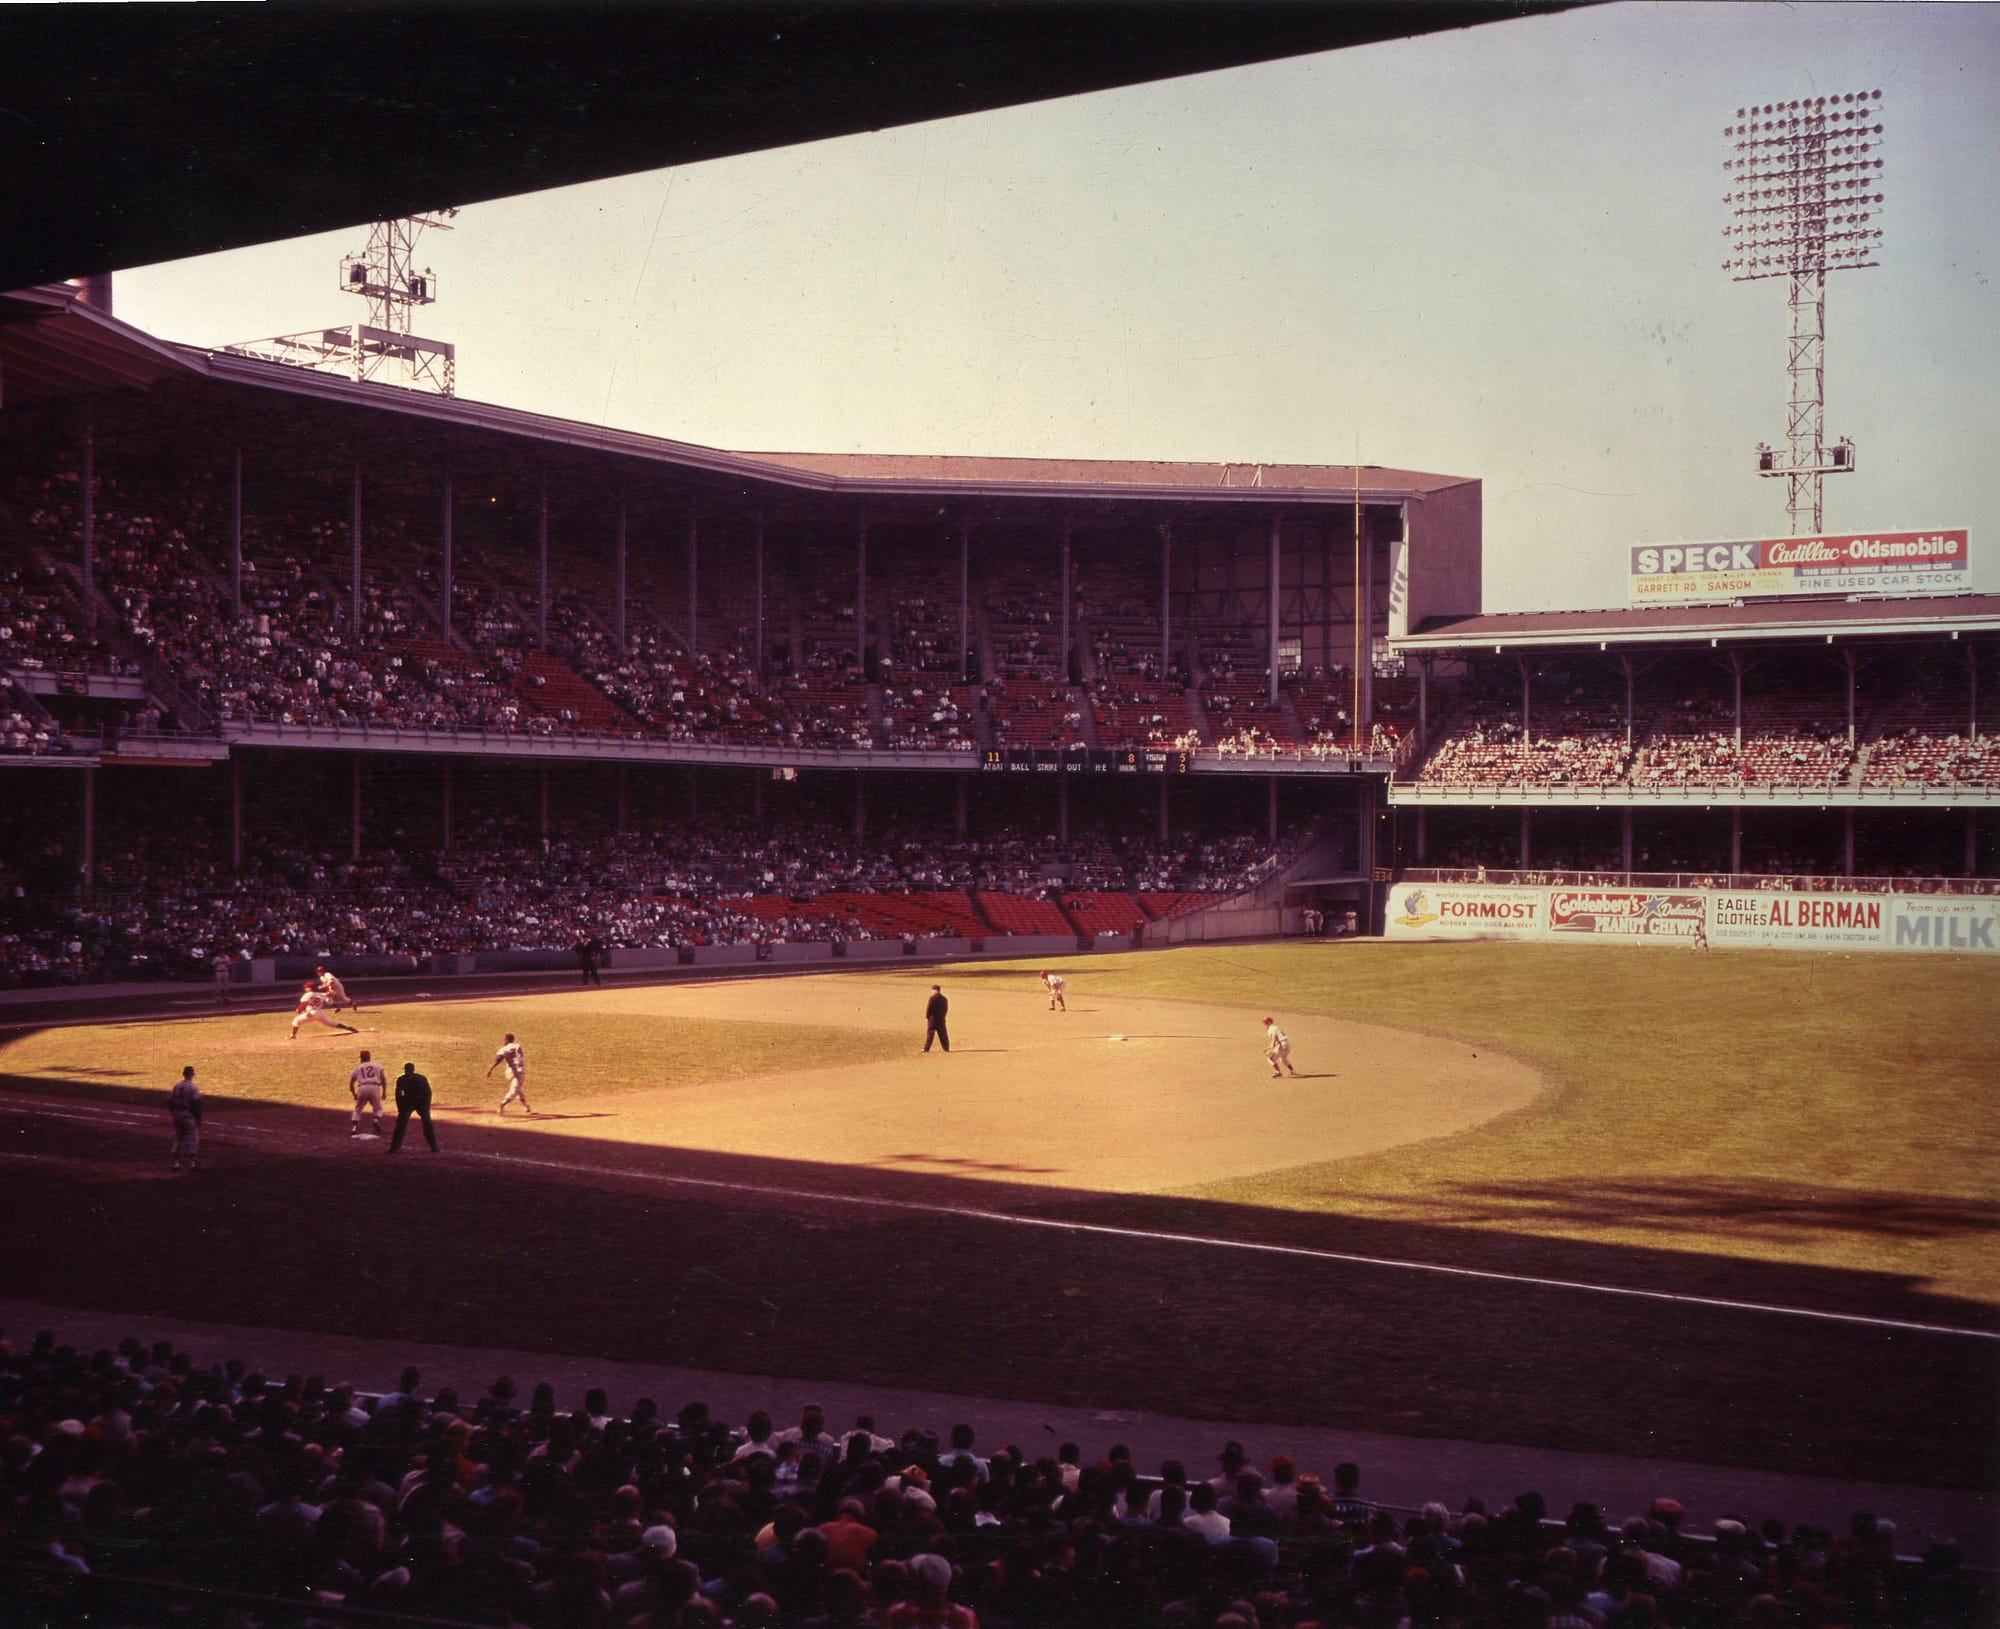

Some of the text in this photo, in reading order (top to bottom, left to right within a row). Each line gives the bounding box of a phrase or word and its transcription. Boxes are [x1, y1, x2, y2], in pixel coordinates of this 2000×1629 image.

[1638, 544, 1756, 573] SPECK
[1800, 573, 1963, 588] FINE USED CAR STOCK
[1638, 583, 1679, 594] GARRETT
[1708, 581, 1752, 592] SANSOM
[988, 752, 1000, 762] 11
[1128, 753, 1135, 763] 8
[1180, 753, 1186, 762] 5
[1011, 763, 1030, 771] BALL
[1067, 763, 1082, 771] OUT
[1179, 763, 1186, 773] 3
[1373, 871, 1392, 882] 334
[1440, 901, 1537, 919] FORMOST
[1554, 893, 1640, 917] Goldenberg's
[1718, 898, 1757, 911] EAGLE
[1905, 902, 1977, 913] Team up with
[1717, 912, 1767, 926] CLOTHES
[1769, 900, 1881, 929] AL BERMAN
[1594, 916, 1700, 936] PEANUT CHEWS
[1896, 915, 1996, 948] MILK
[360, 1066, 375, 1079] 12
